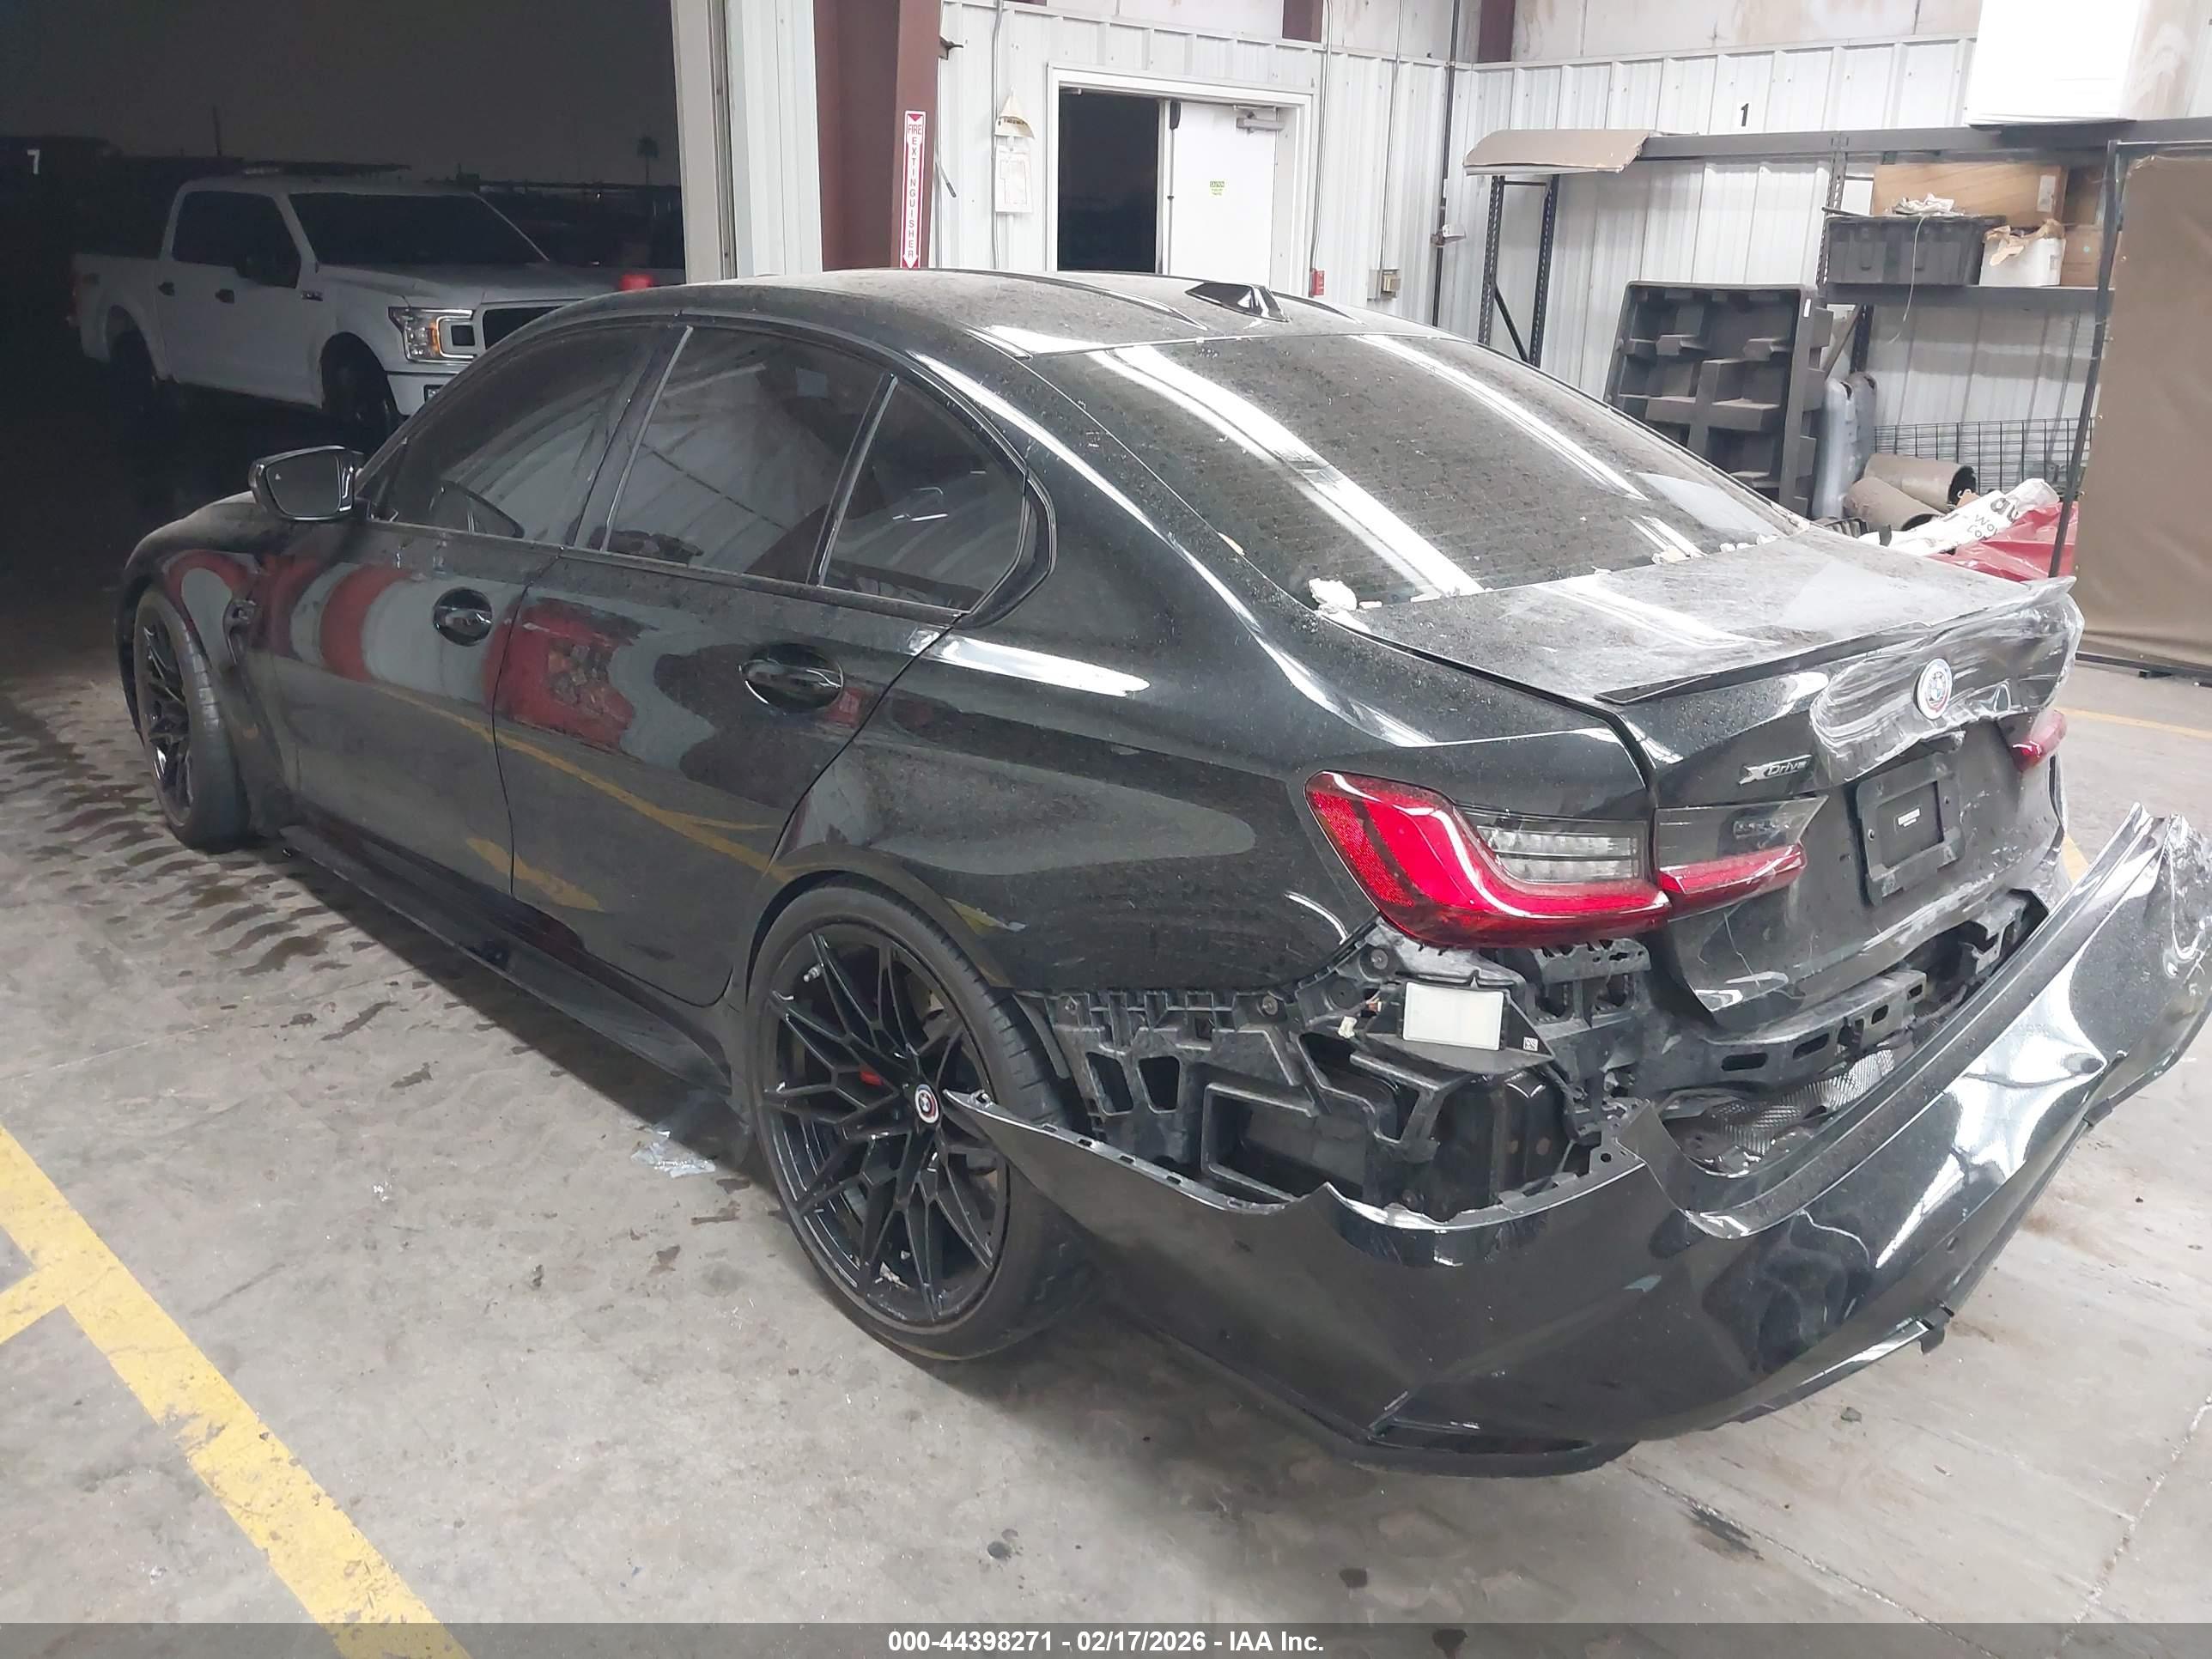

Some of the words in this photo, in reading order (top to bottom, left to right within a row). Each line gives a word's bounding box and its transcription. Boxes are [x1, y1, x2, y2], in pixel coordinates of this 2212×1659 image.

[1741, 102, 1749, 127] 1
[908, 124, 923, 136] FIRE
[27, 149, 40, 174] 7
[908, 137, 918, 258] EXTINGUISHER
